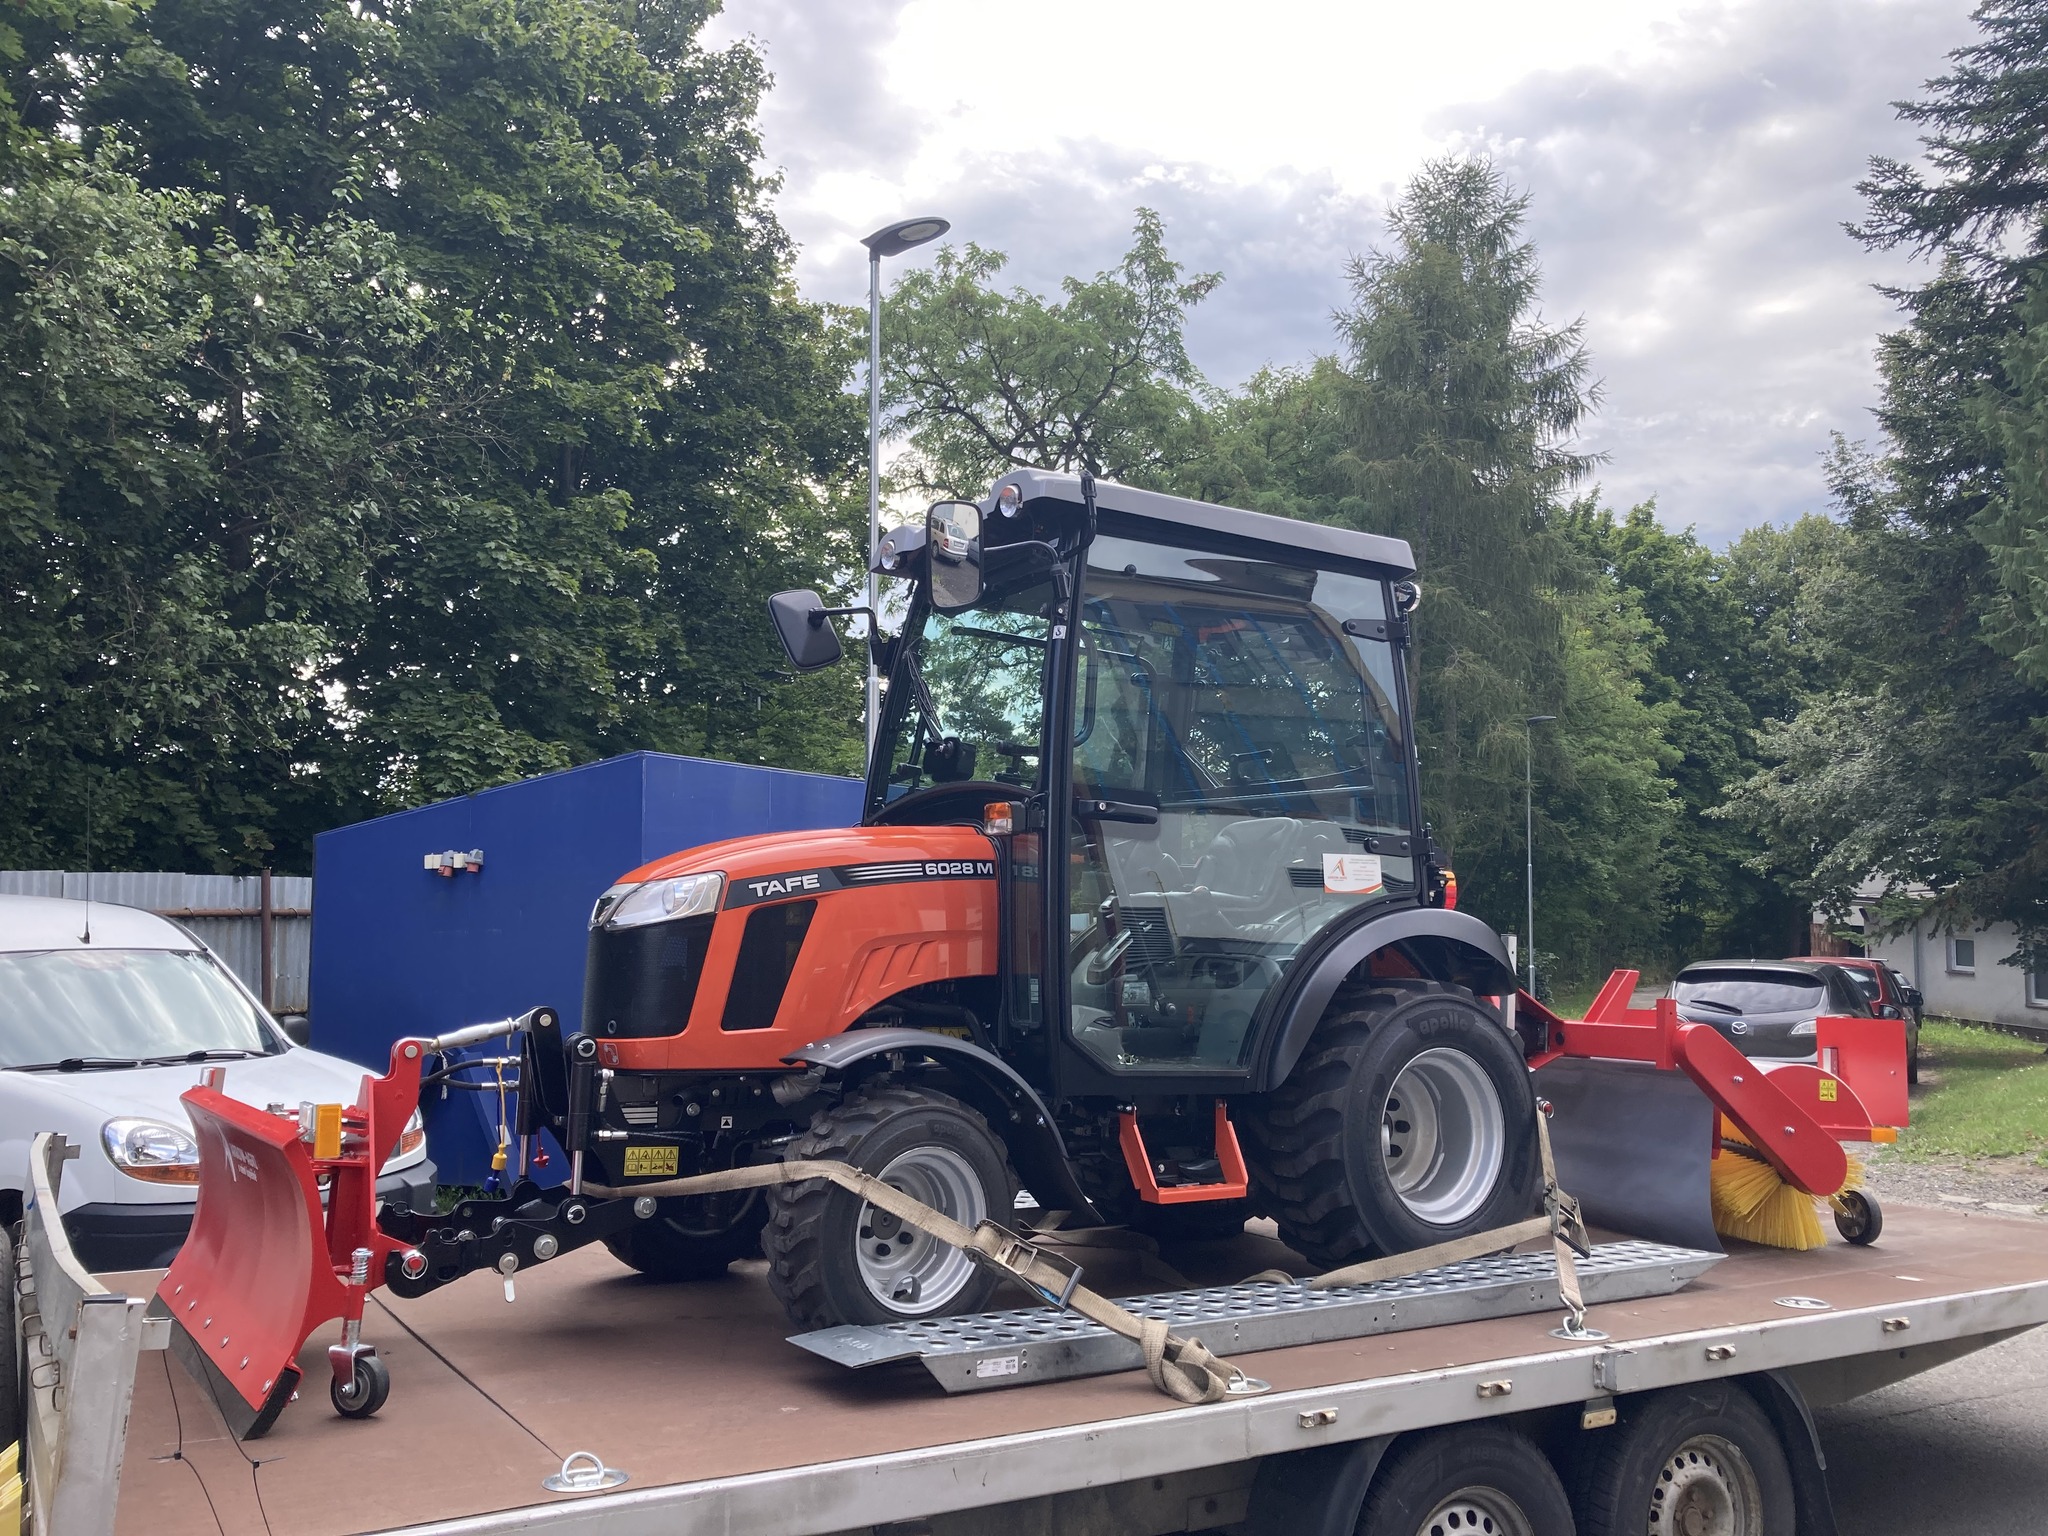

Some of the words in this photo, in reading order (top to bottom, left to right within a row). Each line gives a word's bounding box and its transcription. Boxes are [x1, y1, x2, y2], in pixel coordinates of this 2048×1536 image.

[925, 862, 974, 876] 6028
[977, 862, 994, 875] M
[748, 873, 821, 898] TAFE
[1419, 1011, 1470, 1037] apollo
[933, 1120, 964, 1139] apollo
